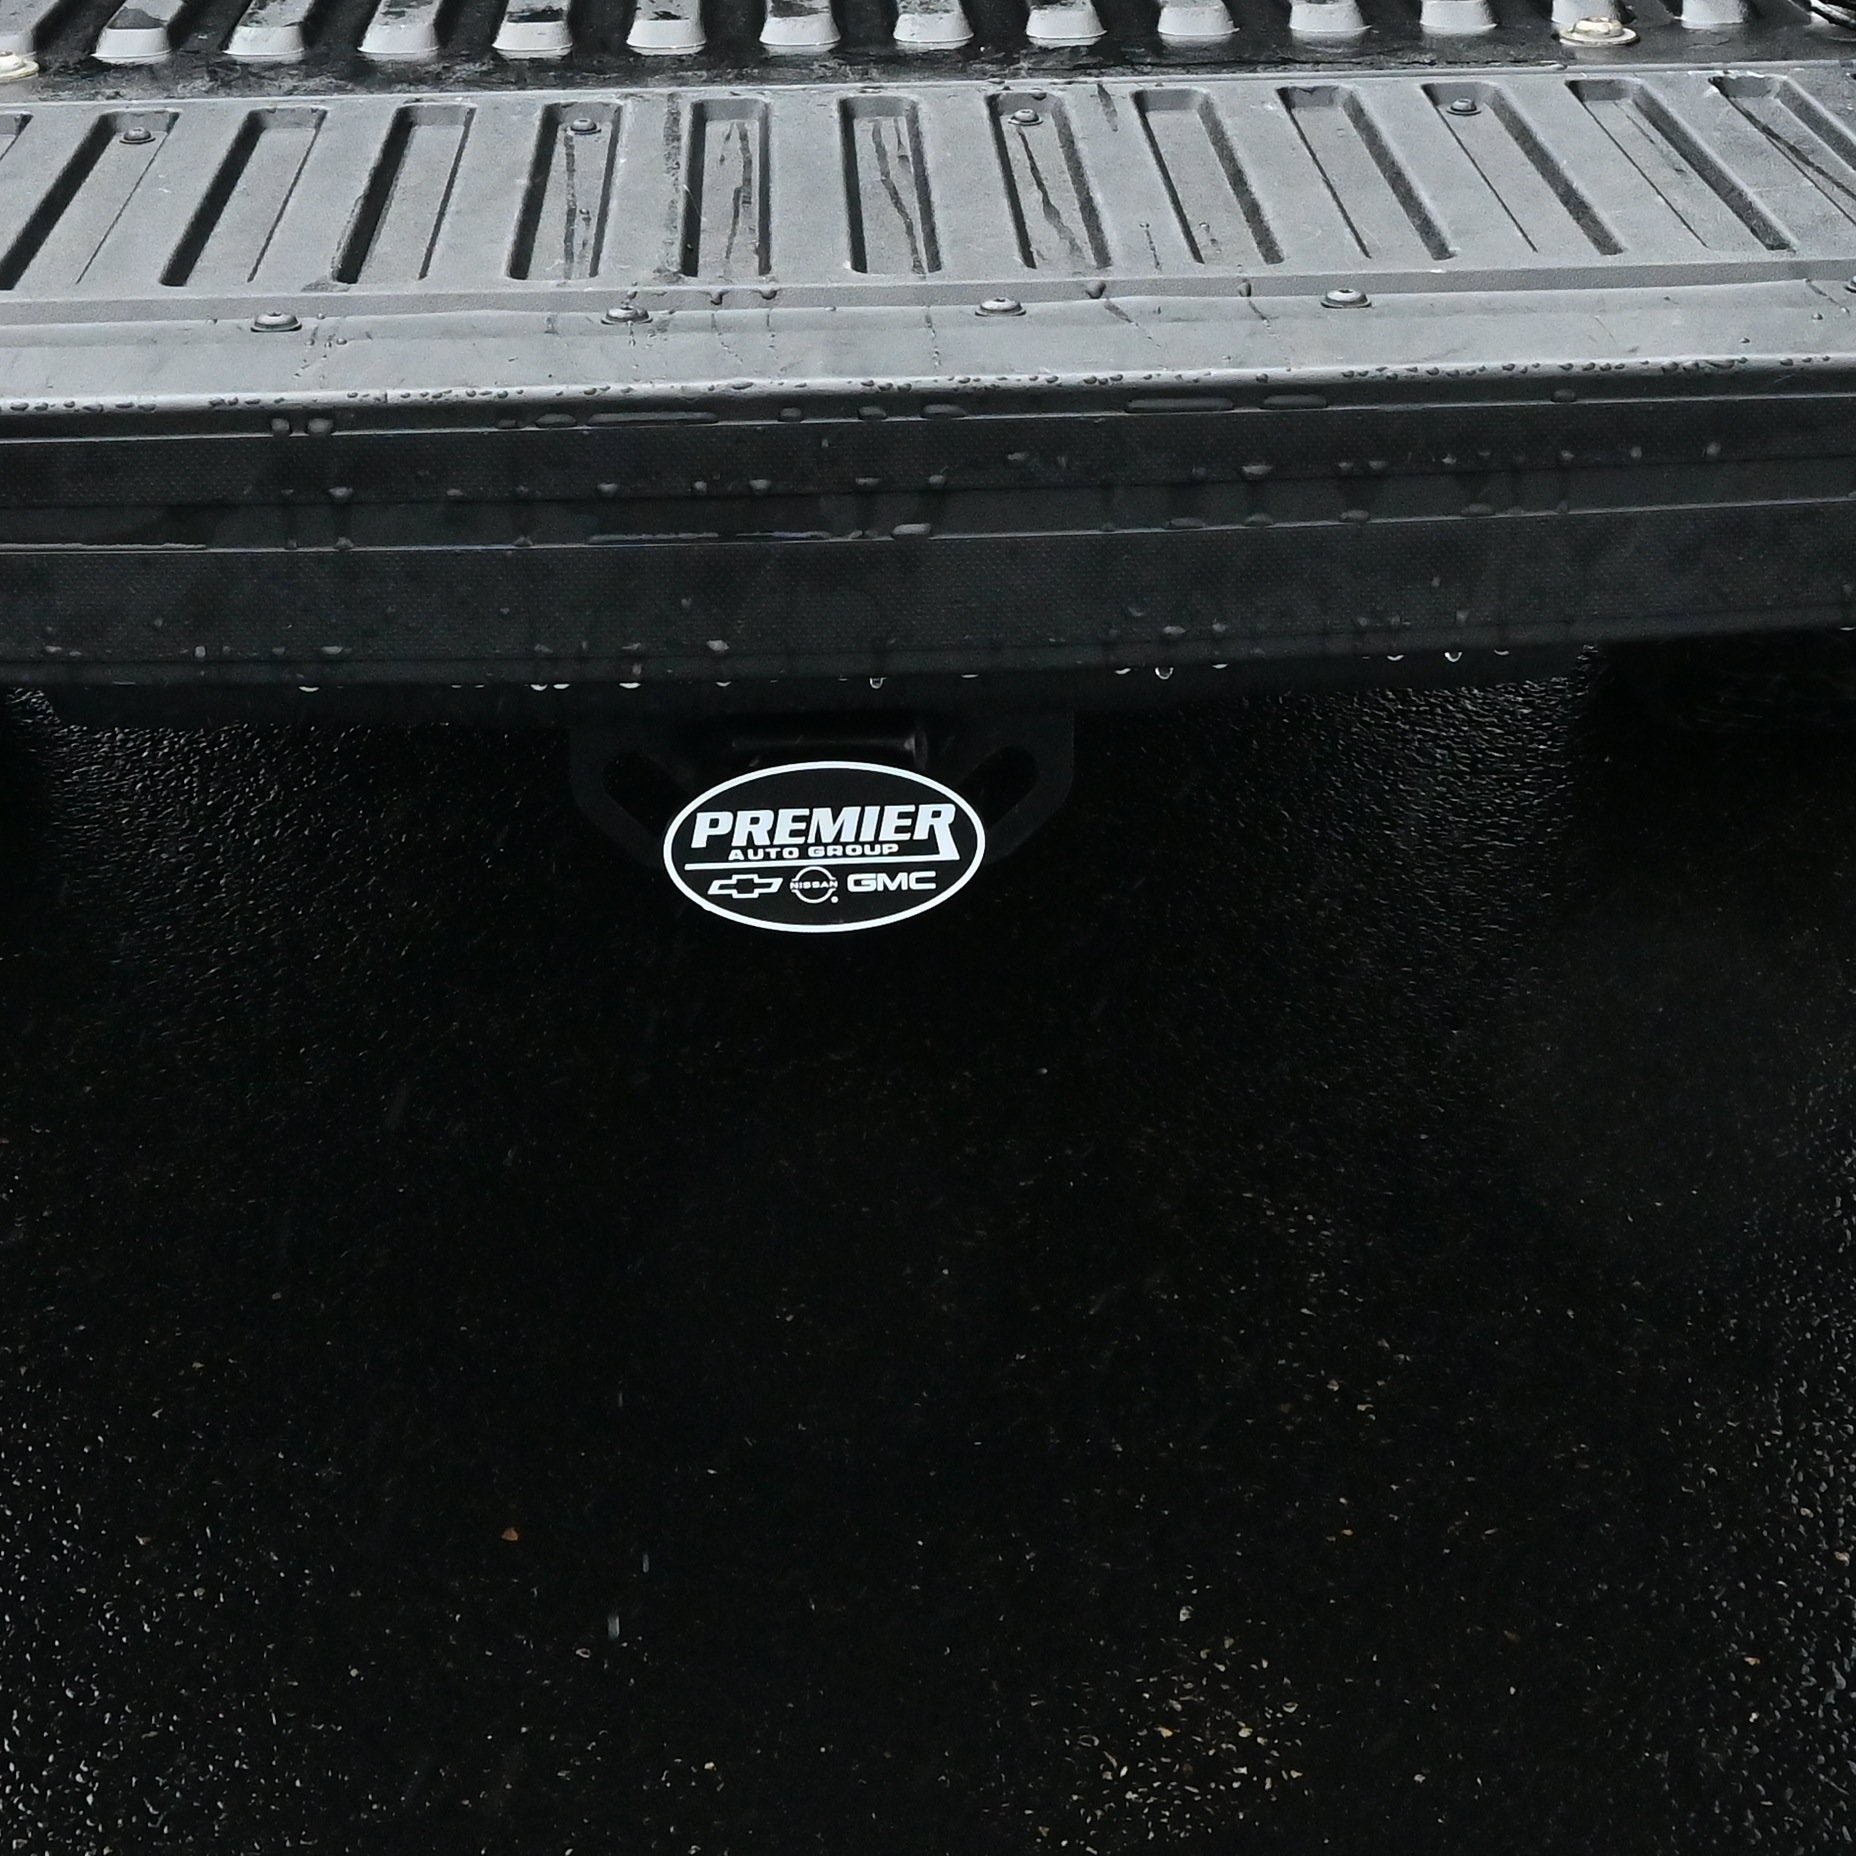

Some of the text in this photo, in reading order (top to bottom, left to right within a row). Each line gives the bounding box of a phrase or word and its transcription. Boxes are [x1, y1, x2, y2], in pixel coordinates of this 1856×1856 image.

[690, 803, 961, 861] PREMIER
[727, 843, 899, 861] AUTO GROUP
[790, 880, 839, 889] NISSAN
[846, 870, 937, 893] GMC
